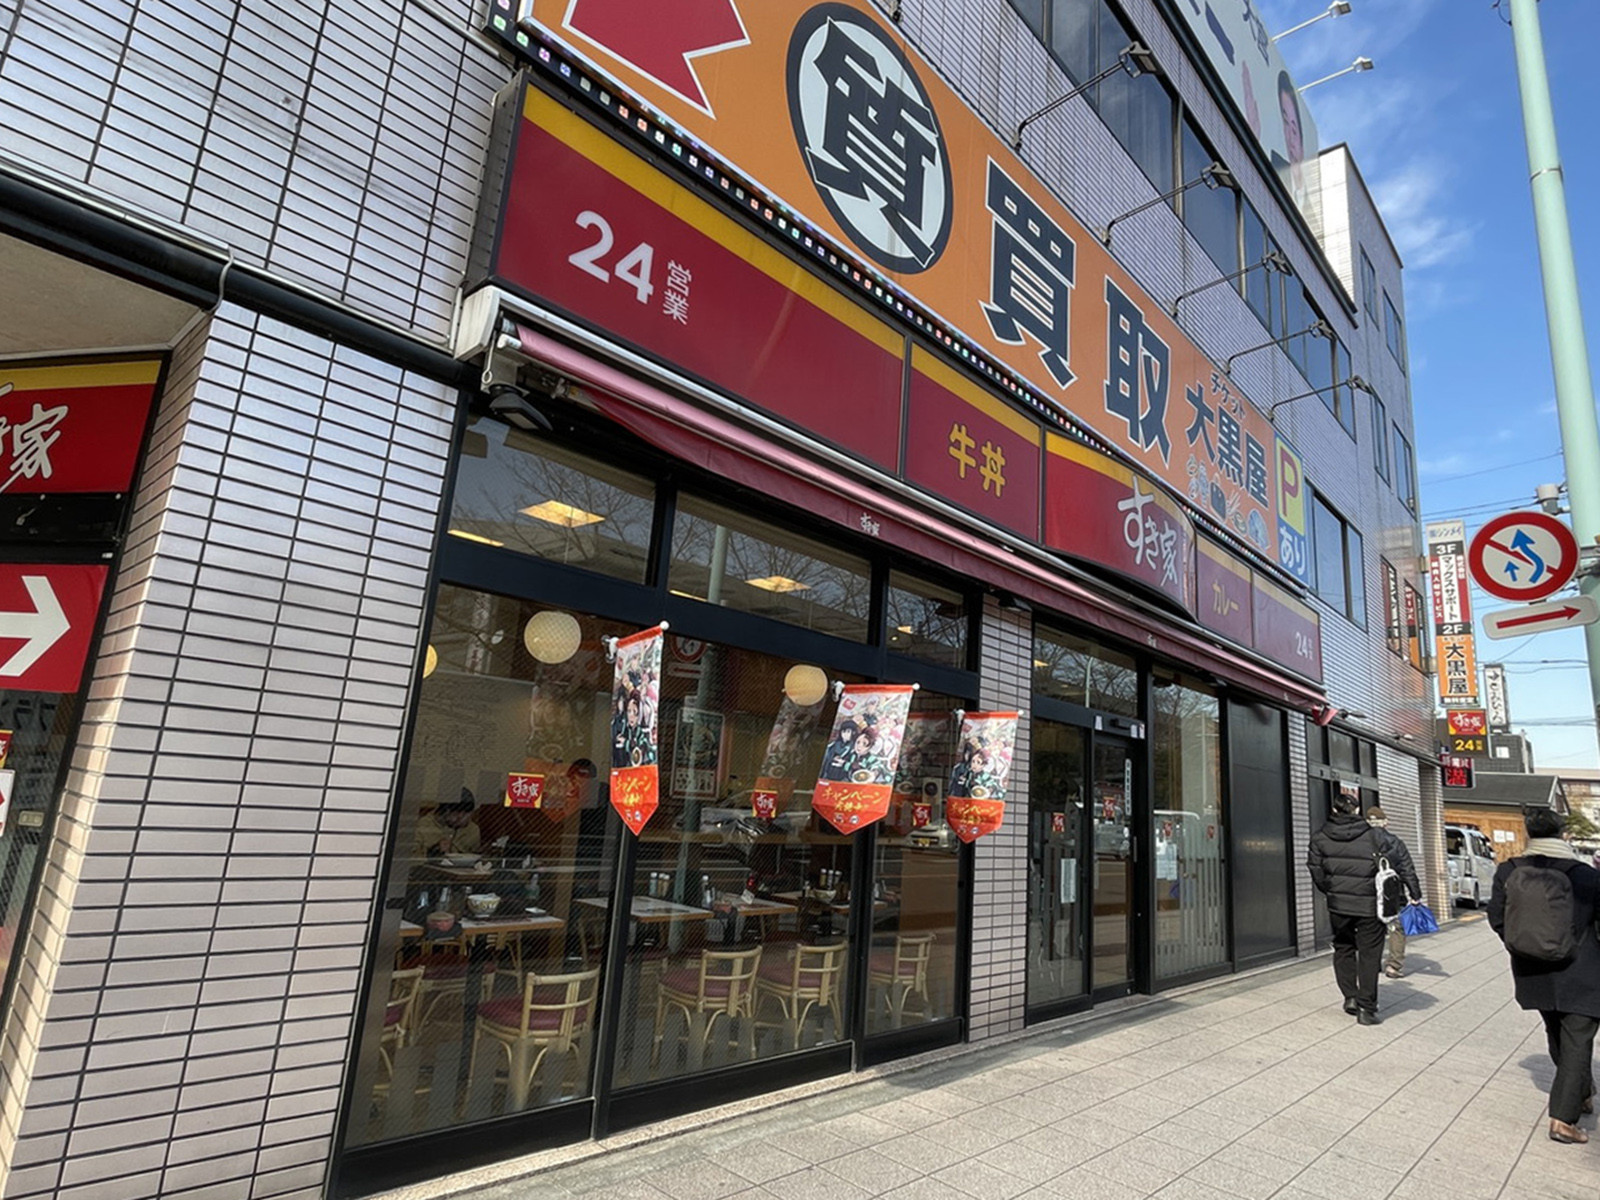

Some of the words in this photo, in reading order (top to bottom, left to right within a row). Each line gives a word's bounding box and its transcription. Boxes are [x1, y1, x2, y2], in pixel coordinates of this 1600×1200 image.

[568, 209, 654, 304] 24
[663, 260, 692, 325] 営業
[979, 155, 1171, 469] 買取
[1210, 372, 1246, 420] チケット
[949, 423, 1006, 497] 牛丼
[1185, 381, 1269, 509] 大黒屋
[1279, 445, 1299, 517] P
[1118, 473, 1178, 587] すき家
[1279, 526, 1305, 576] あり
[1436, 543, 1457, 555] 3F
[1212, 579, 1240, 616] カレー
[1442, 556, 1457, 620] マックスサポート
[1442, 624, 1463, 635] 2F
[1445, 642, 1469, 694] 大黒屋
[1453, 711, 1482, 729] すき家
[1455, 739, 1475, 751] 24
[511, 776, 540, 798] すき家
[822, 786, 884, 804] キャンペーン
